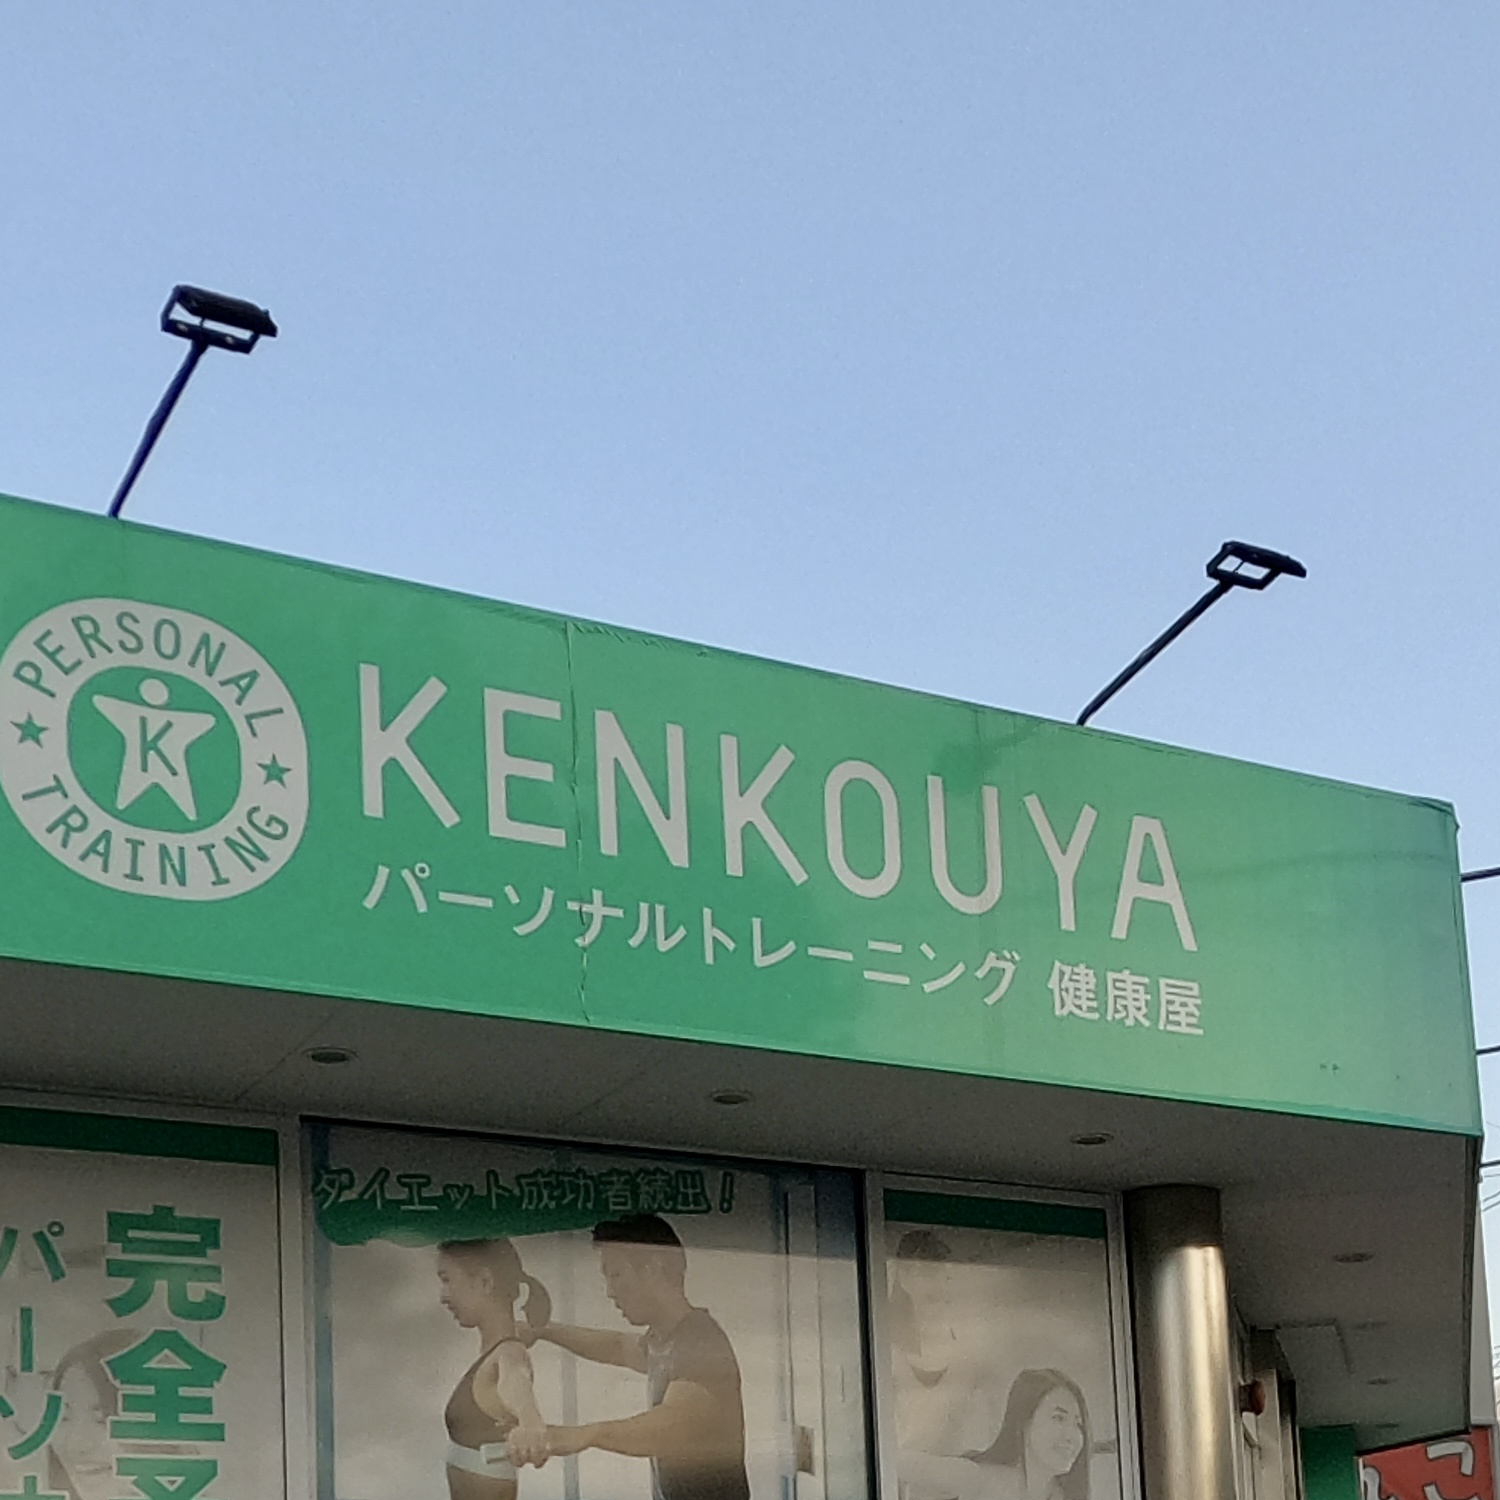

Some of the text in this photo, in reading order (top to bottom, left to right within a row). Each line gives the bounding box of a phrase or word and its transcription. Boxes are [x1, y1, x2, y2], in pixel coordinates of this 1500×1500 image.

[12, 611, 286, 738] PERSONAL
[138, 715, 180, 778] K
[358, 662, 1199, 953] KENKOUYA
[21, 774, 290, 888] TRAINING
[362, 861, 1205, 1037] パーソナルトレーニング 健康屋
